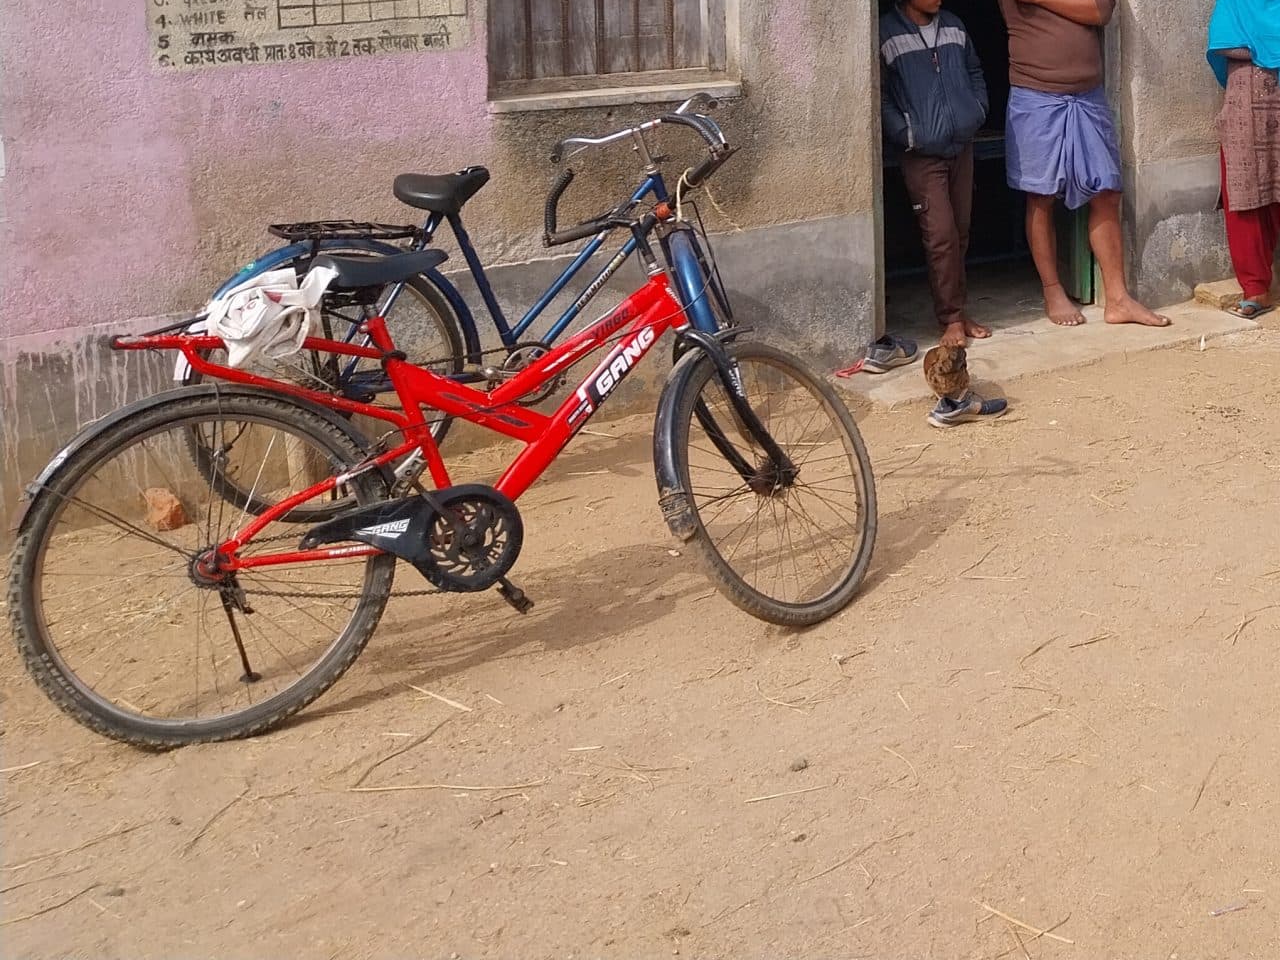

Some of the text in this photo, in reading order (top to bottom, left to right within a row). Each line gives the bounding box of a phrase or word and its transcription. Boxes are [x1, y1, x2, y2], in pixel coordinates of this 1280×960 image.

[155, 14, 173, 29] 4.
[179, 9, 226, 26] WHITE
[158, 34, 170, 50] 5
[340, 42, 351, 57] 2
[352, 37, 376, 56] तक
[595, 325, 655, 396] GANG
[372, 519, 410, 535] GANG
